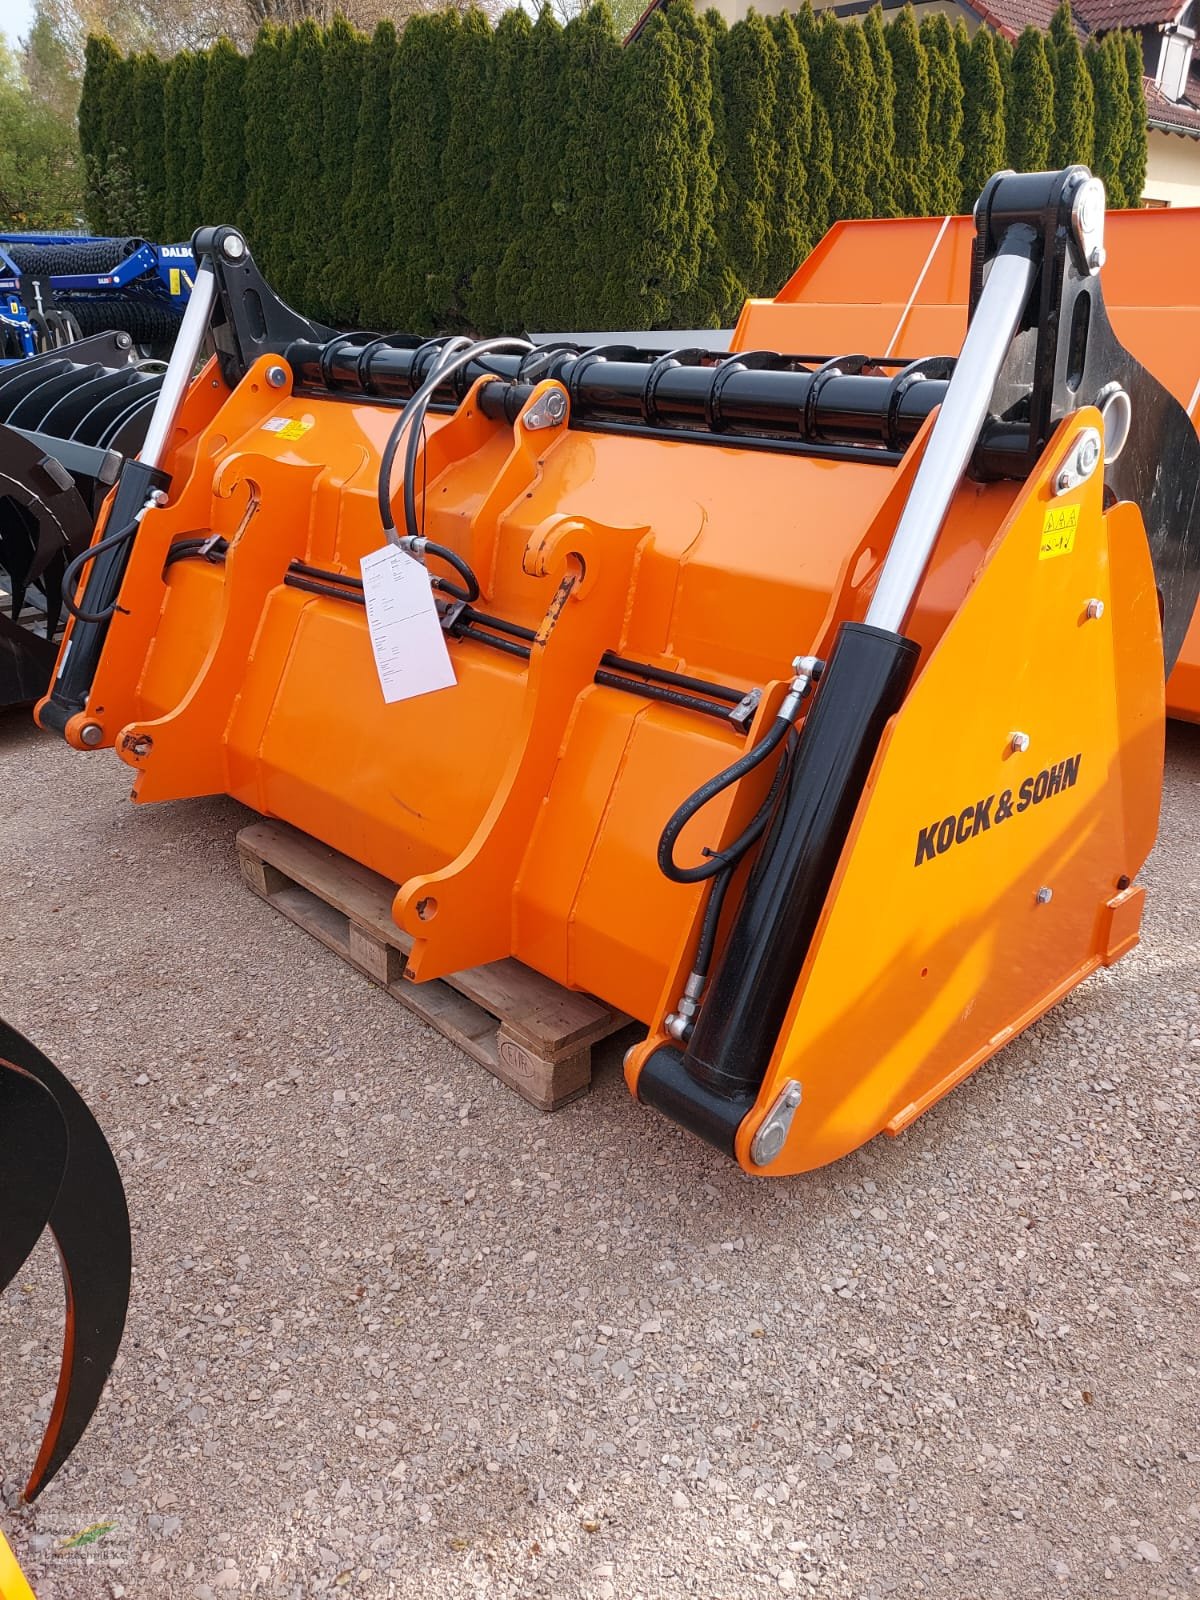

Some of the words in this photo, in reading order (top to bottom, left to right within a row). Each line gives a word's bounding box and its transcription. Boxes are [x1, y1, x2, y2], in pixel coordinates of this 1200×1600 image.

[914, 794, 995, 867] KOCK
[994, 789, 1013, 825] &
[1016, 753, 1082, 813] SOHN
